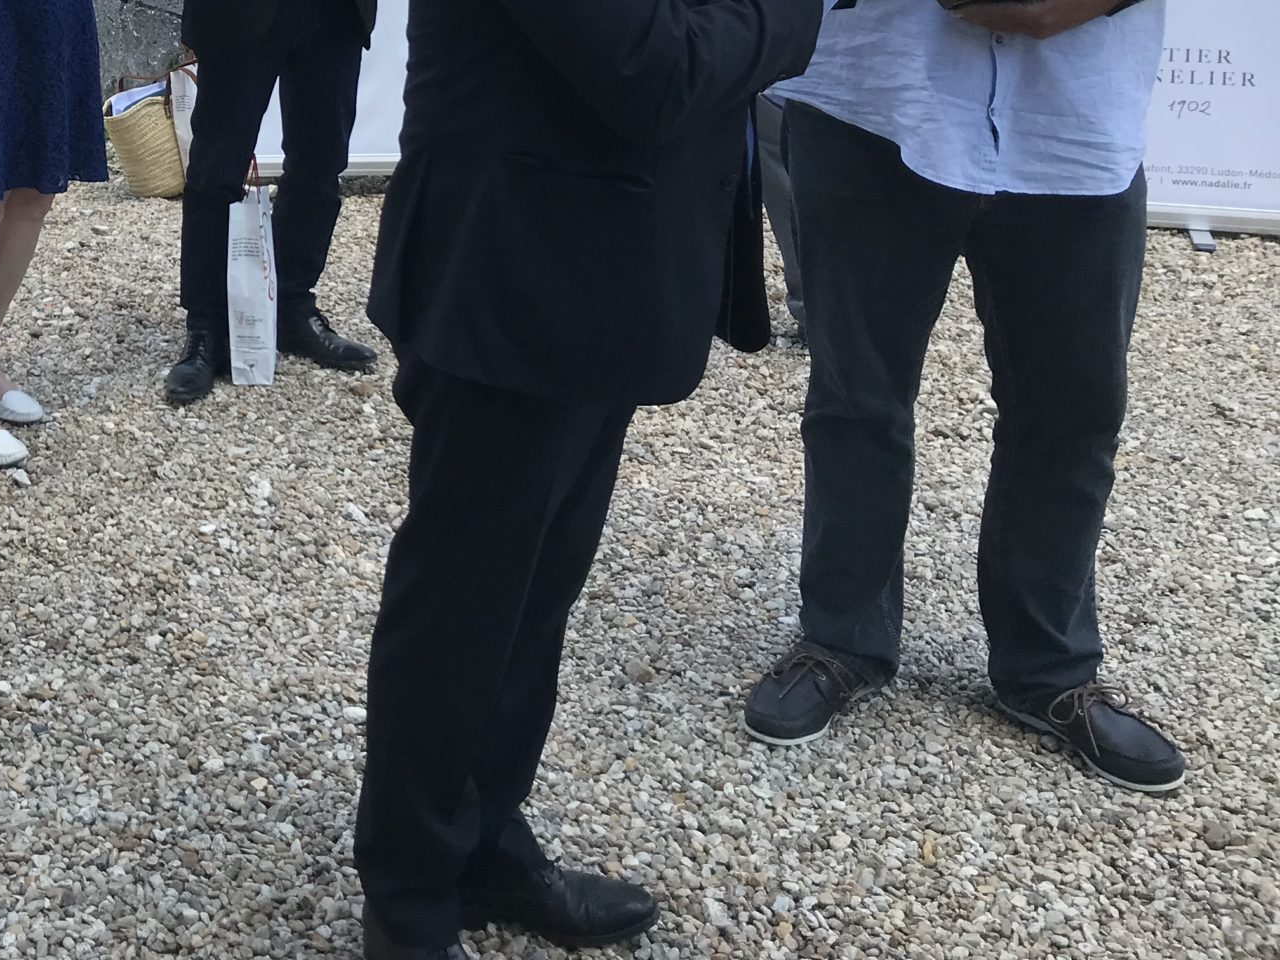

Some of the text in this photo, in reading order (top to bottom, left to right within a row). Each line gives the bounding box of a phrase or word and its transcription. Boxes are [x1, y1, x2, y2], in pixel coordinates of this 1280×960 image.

[1163, 47, 1232, 65] TIER
[1168, 99, 1212, 119] 1902
[1144, 164, 1174, 175] afont,
[1176, 165, 1208, 175] 33290
[1171, 179, 1253, 189] www.nadalie.fr
